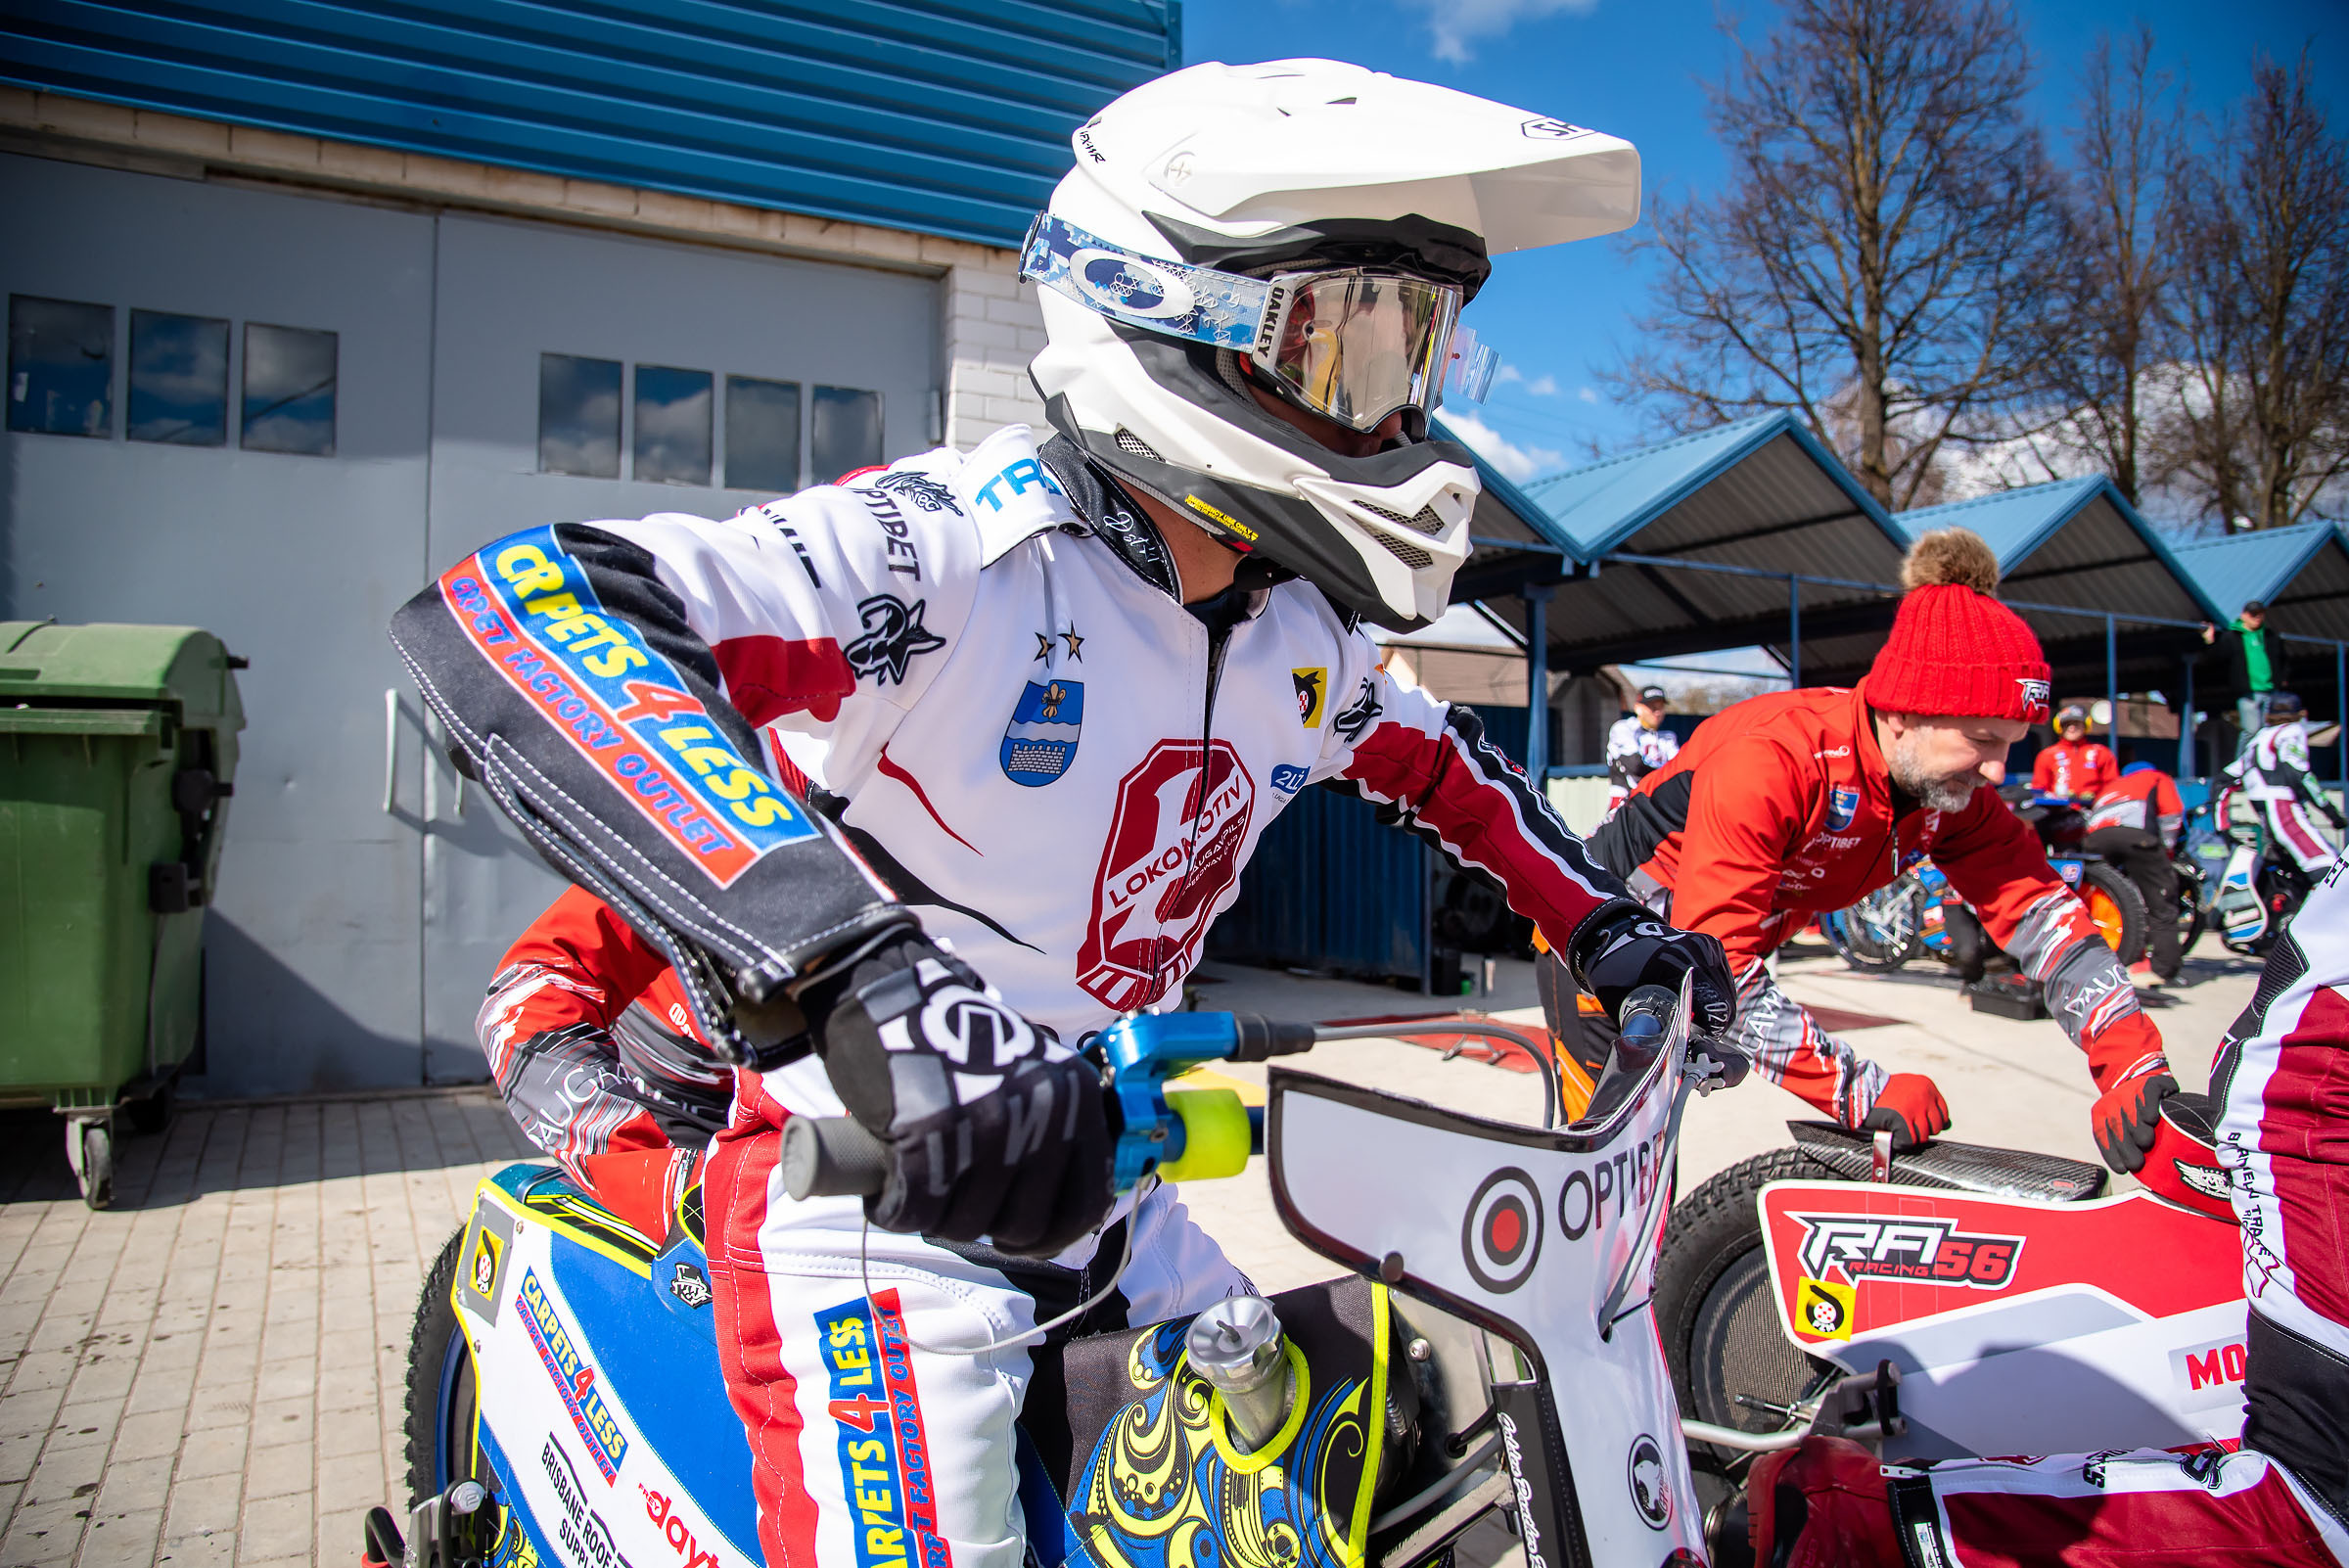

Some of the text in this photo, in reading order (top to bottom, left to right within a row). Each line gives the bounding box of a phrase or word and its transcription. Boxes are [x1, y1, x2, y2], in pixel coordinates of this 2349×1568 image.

[1258, 287, 1285, 358] OAKLEY
[616, 678, 706, 724] 4
[503, 648, 622, 752] FACTORY
[614, 754, 736, 856] OUTLET
[660, 726, 793, 827] LESS
[1849, 1262, 1929, 1277] RACING
[1932, 1240, 2012, 1280] 56
[524, 1274, 624, 1459] CARPETS 4 LESS
[829, 1317, 873, 1386] LESS
[516, 1298, 614, 1479] CARPET FACTORY OUTLET
[829, 1393, 890, 1433] 4
[894, 1390, 930, 1504] FACTORY
[541, 1442, 584, 1530] BRISBANE
[638, 1483, 660, 1510] FREY
